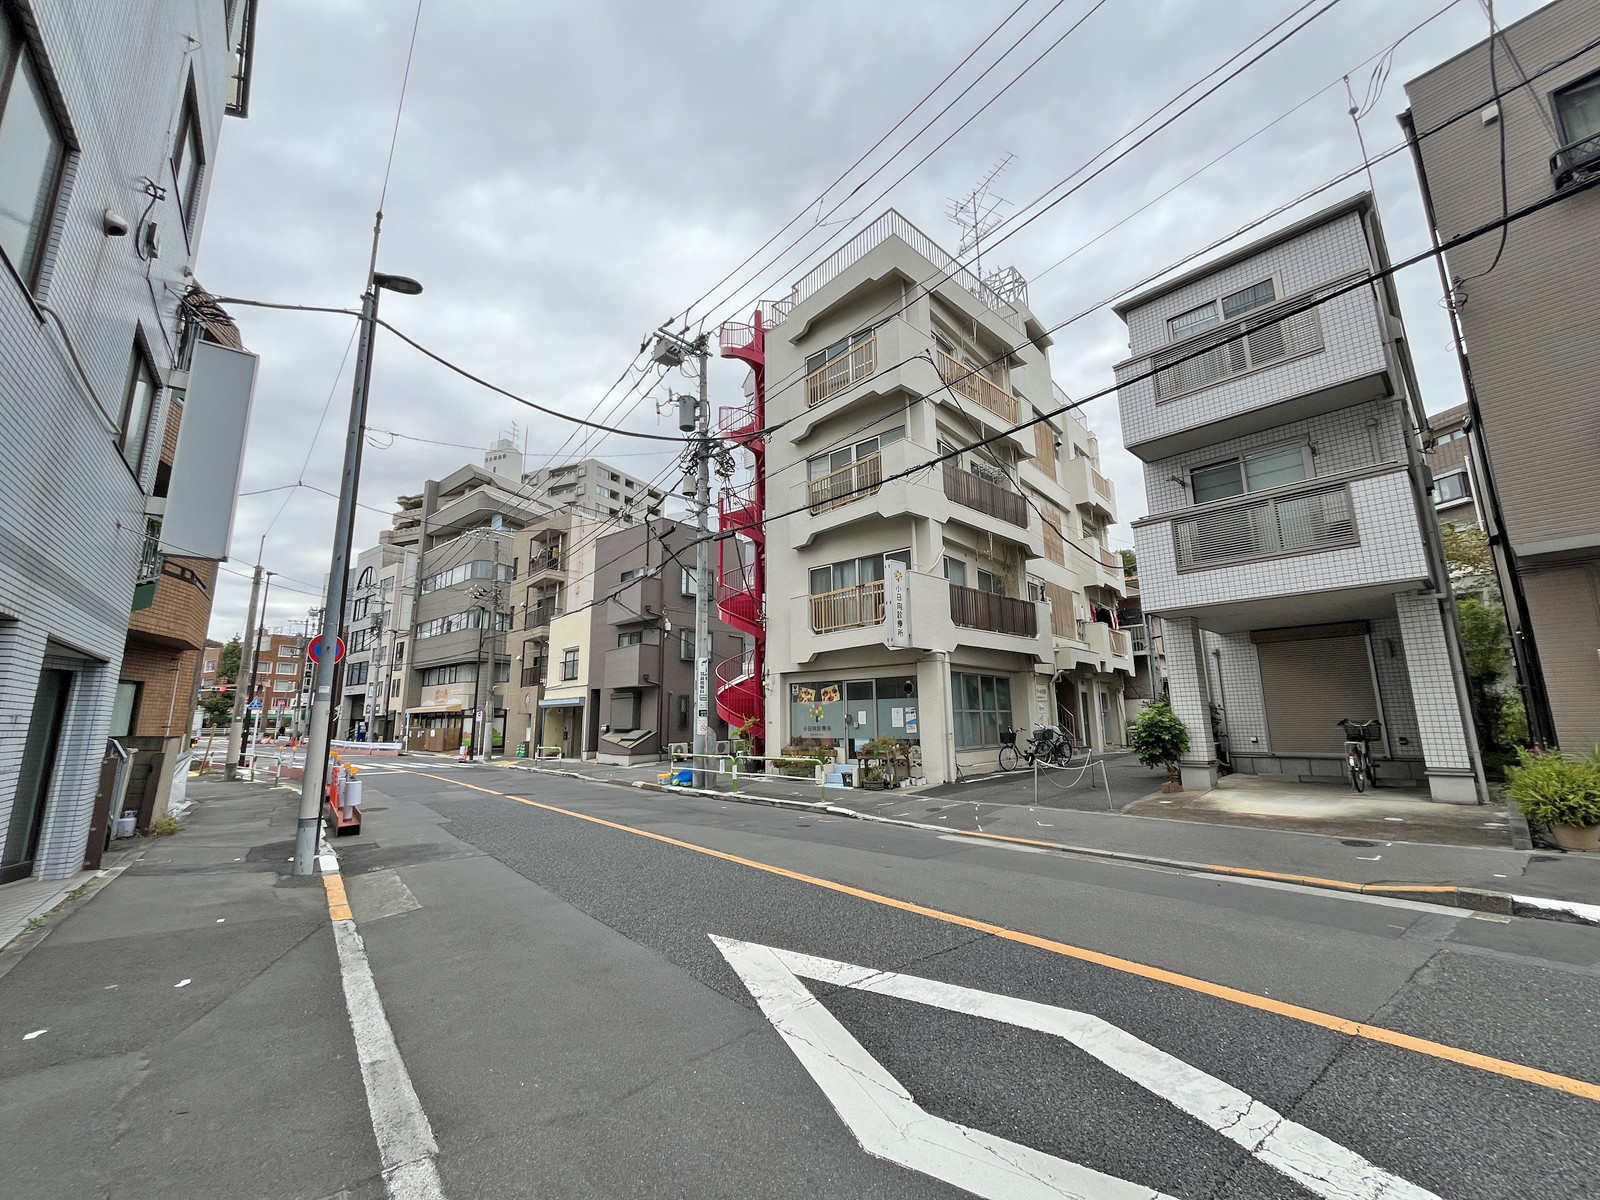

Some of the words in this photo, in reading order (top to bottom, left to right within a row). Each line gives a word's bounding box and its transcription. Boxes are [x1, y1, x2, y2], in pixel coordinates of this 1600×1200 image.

[895, 585, 904, 638] 小日向診療所
